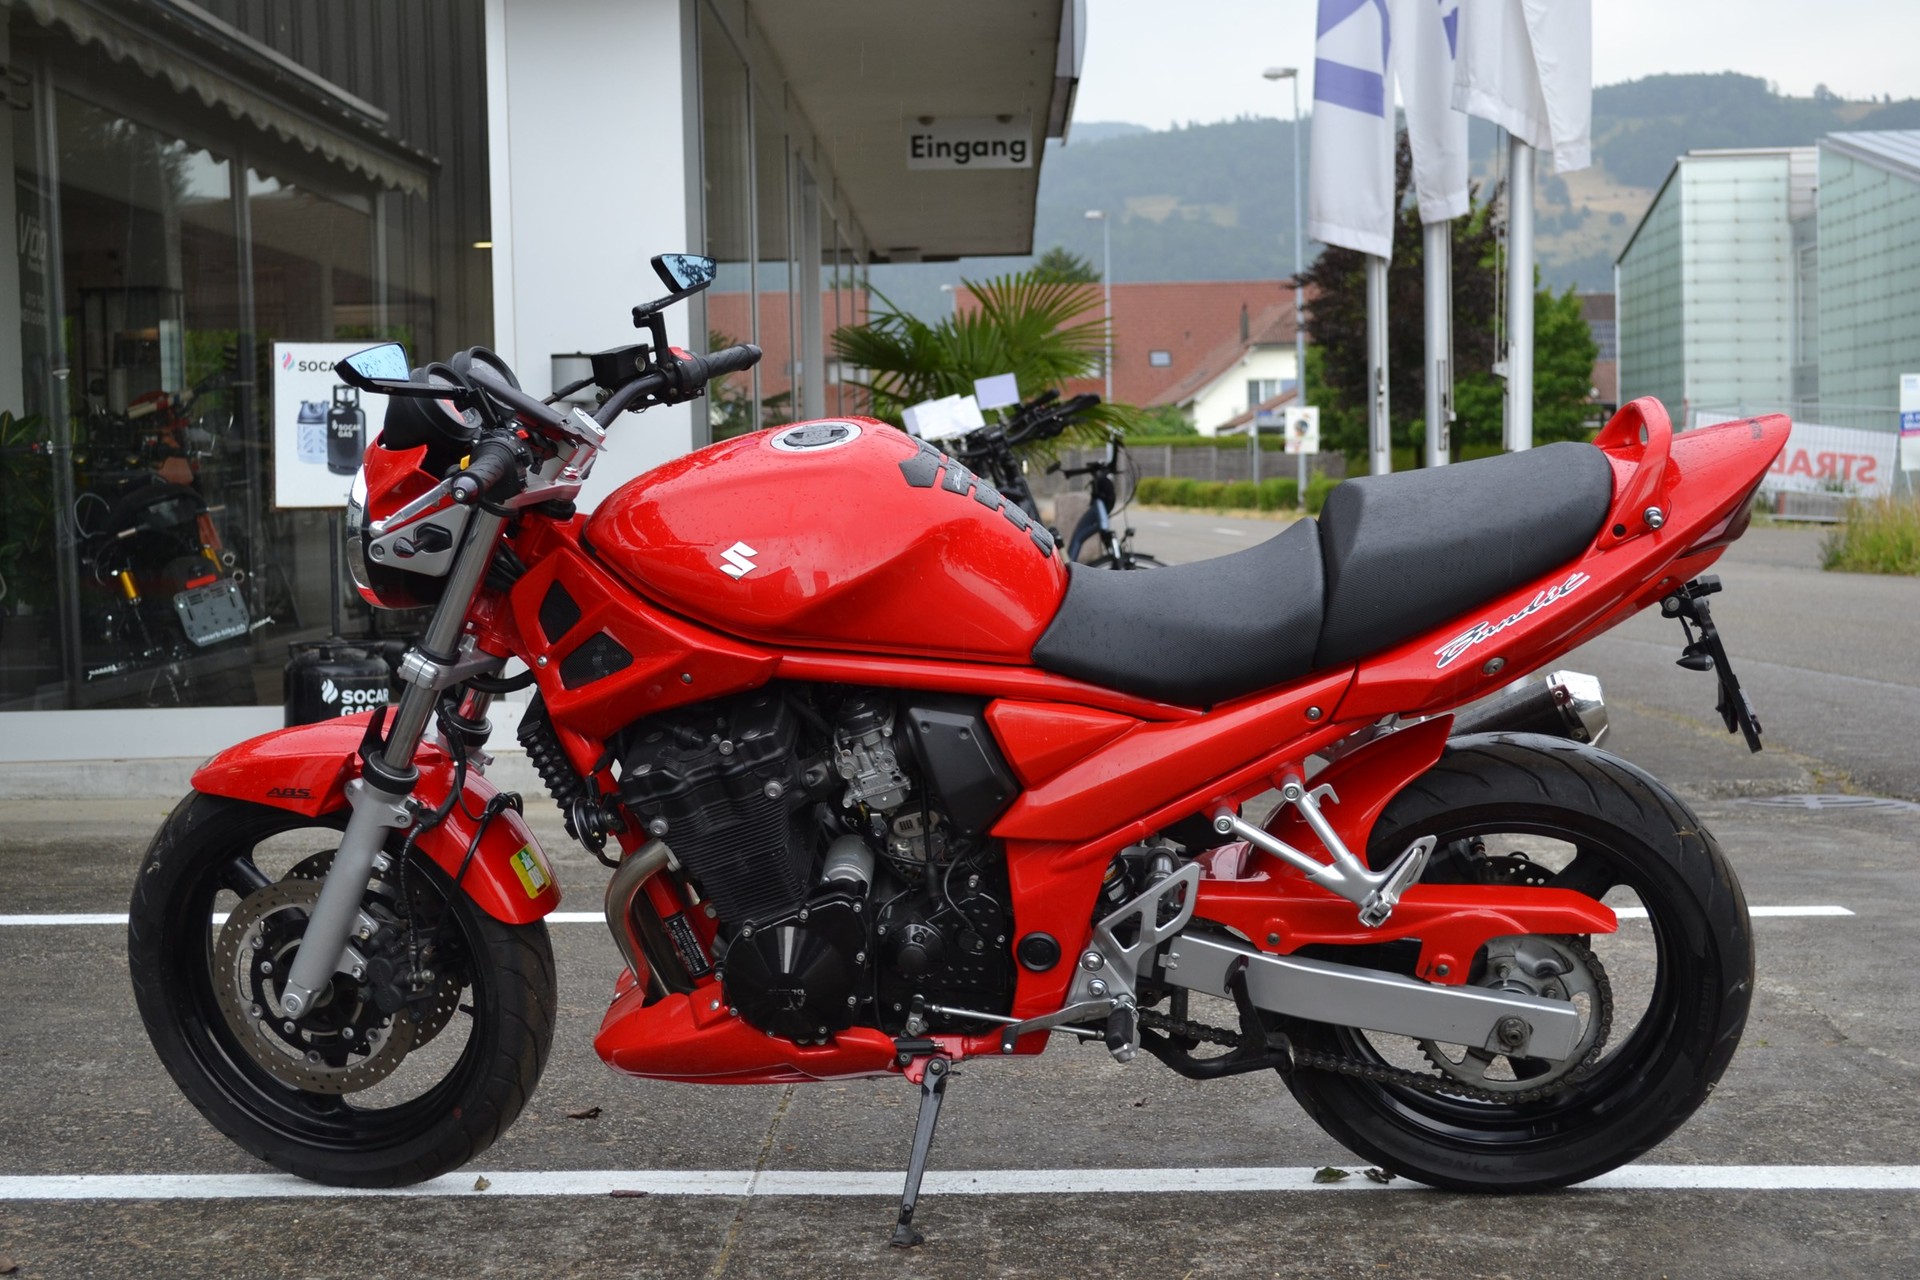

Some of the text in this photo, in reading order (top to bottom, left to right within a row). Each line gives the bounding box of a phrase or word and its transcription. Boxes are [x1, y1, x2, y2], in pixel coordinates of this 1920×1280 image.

[911, 135, 1025, 164] Eingang
[298, 361, 336, 372] SOCA
[1434, 572, 1590, 668] Bandit
[341, 688, 388, 704] SOCAR
[266, 787, 311, 798] ABS
